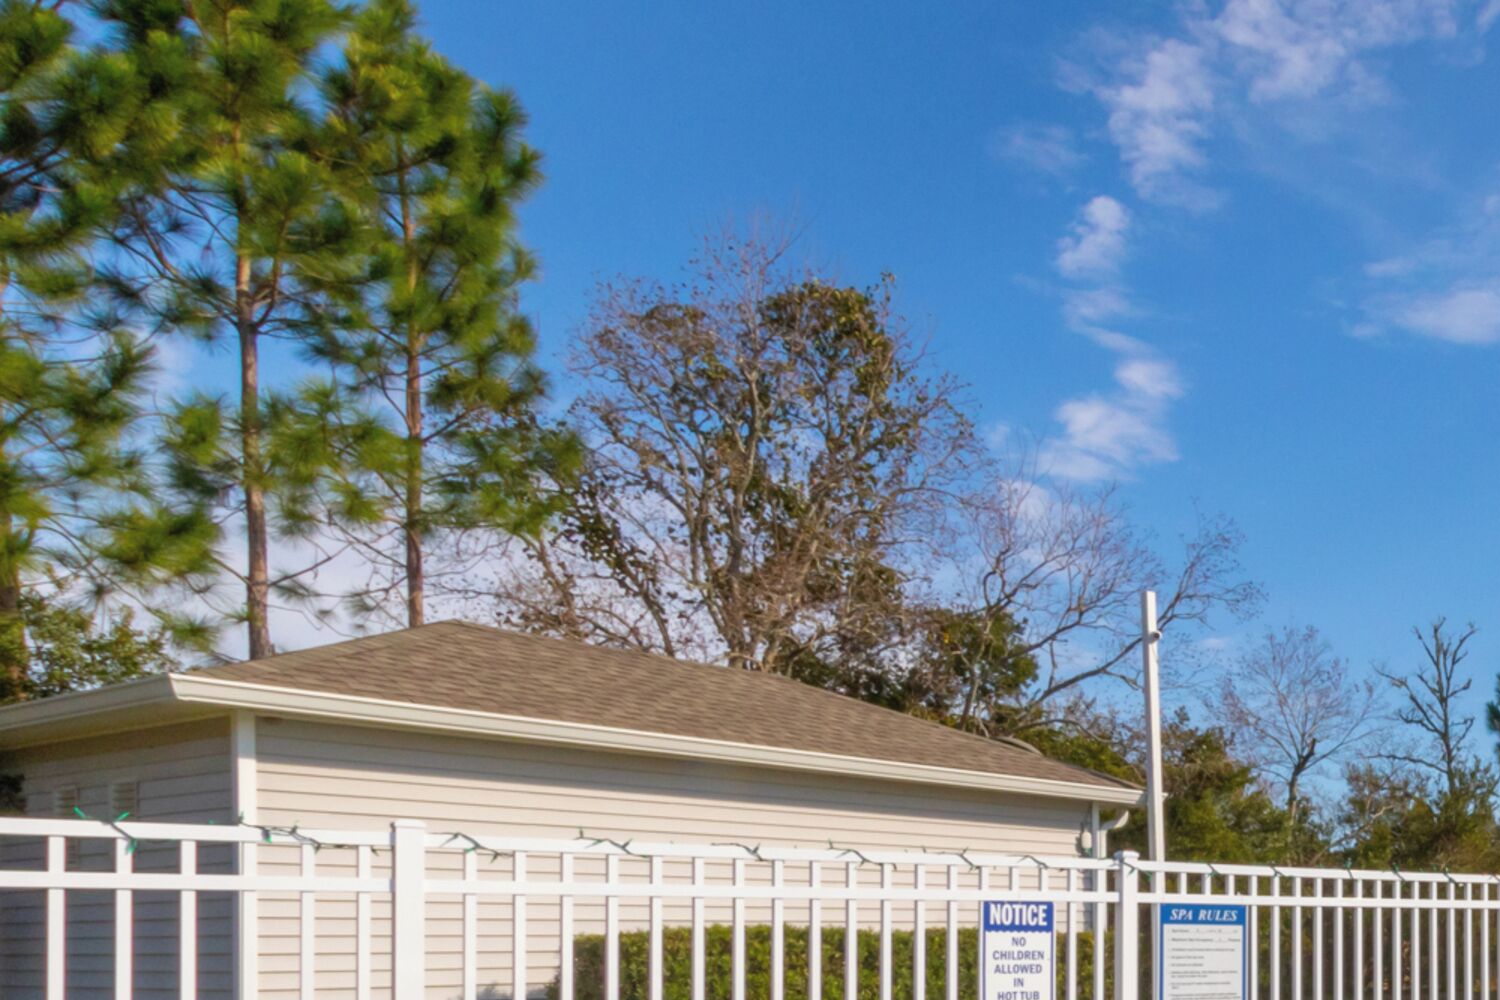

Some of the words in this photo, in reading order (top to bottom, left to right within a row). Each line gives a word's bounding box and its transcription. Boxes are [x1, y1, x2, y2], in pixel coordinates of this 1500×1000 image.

[989, 903, 1048, 926] NOTICE
[1170, 909, 1193, 921] SPA
[1198, 909, 1238, 921] RULES
[1012, 937, 1026, 946] NO
[992, 950, 1045, 961] CHILDREN
[994, 964, 1042, 974] ALLOWED
[1013, 978, 1024, 987] IN
[997, 991, 1017, 1000] HOT
[1020, 991, 1040, 1000] TUB
